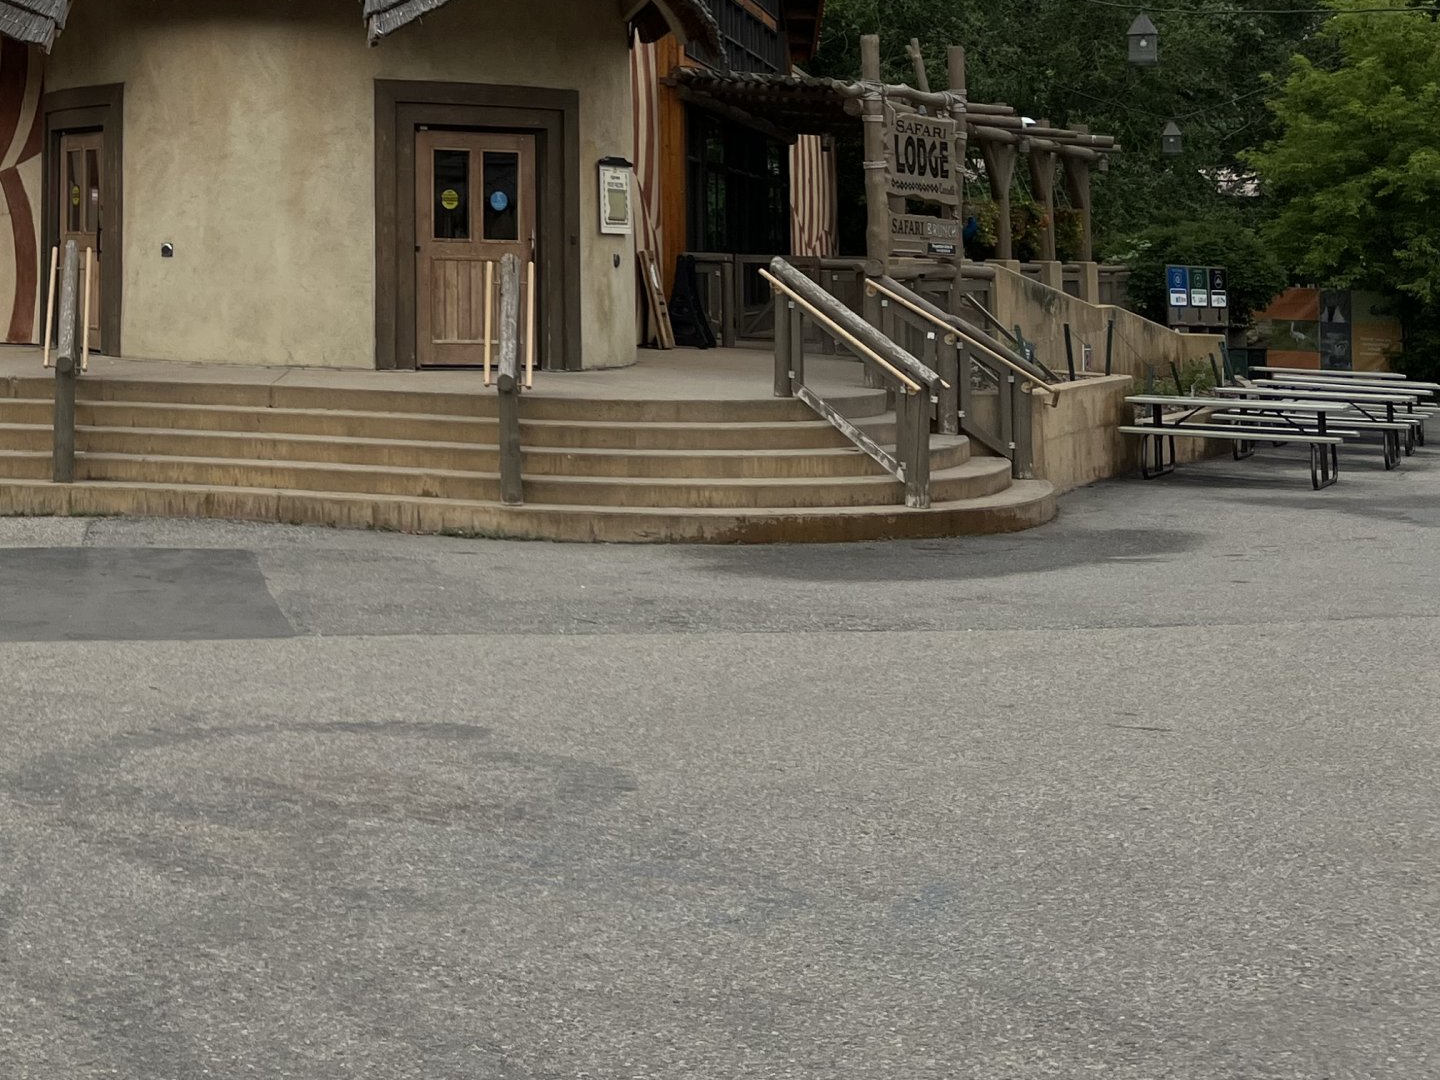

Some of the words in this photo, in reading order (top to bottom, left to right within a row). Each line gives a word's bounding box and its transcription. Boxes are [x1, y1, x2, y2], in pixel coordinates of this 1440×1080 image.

[895, 119, 946, 139] SAFARI
[894, 134, 949, 179] LODGE
[891, 218, 924, 236] SAFARI
[927, 223, 958, 238] BRUNCH
